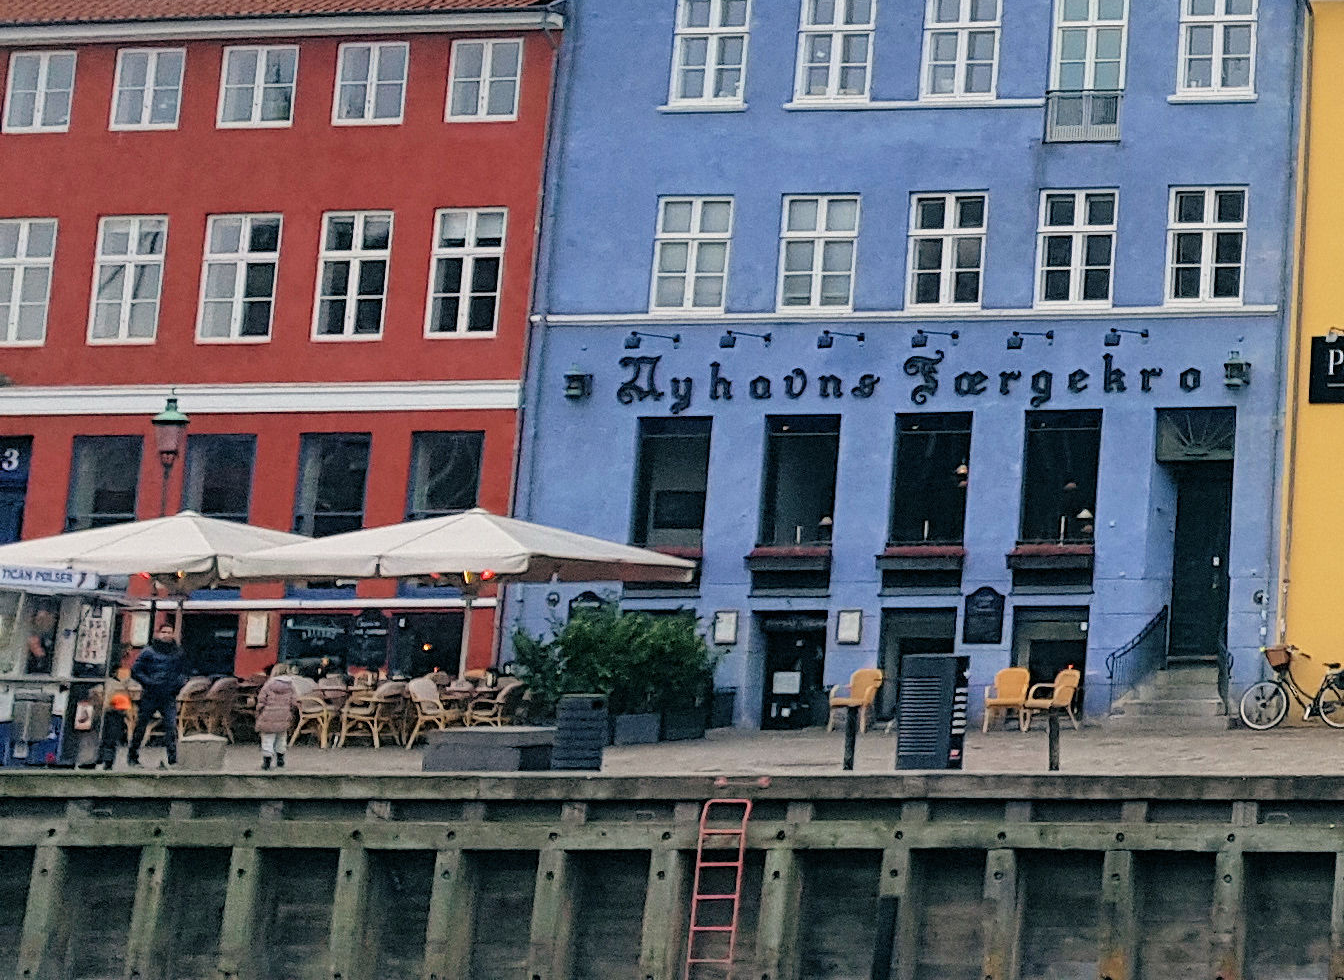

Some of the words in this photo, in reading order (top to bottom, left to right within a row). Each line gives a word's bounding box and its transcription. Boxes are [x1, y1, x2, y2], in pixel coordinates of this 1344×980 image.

[616, 354, 881, 415] Nyhavns
[902, 349, 1202, 408] Færgekro
[2, 448, 20, 471] 3
